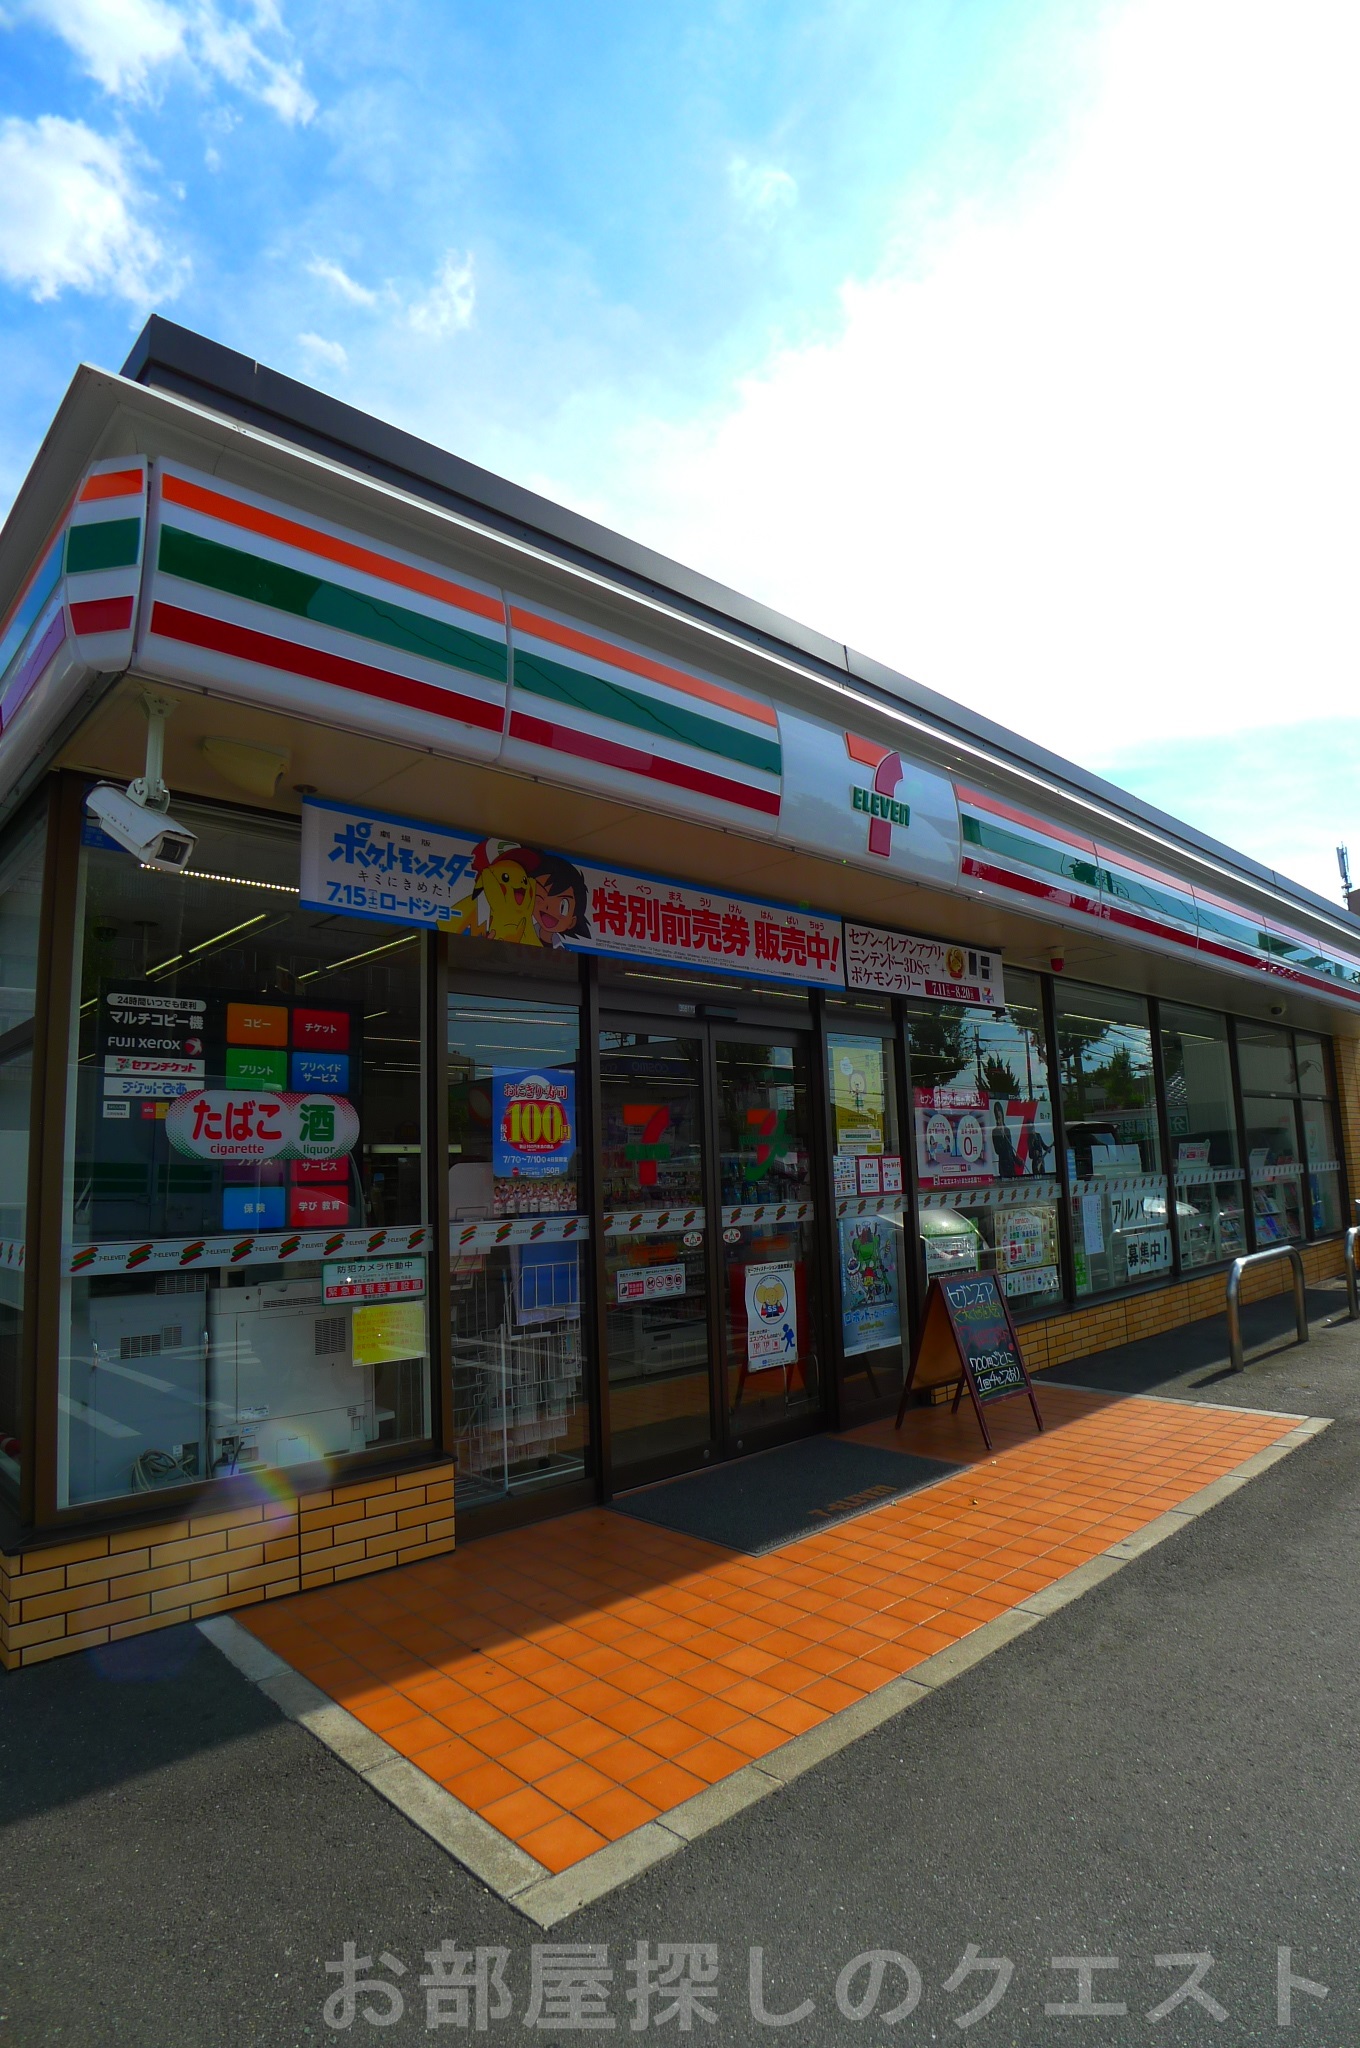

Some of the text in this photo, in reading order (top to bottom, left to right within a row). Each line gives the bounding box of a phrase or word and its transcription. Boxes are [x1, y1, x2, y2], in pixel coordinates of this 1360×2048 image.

[380, 830, 432, 848] 劇場版
[328, 822, 478, 887] ポケットモンスター
[604, 878, 618, 889] とく
[636, 885, 652, 895] べつ
[668, 891, 683, 902] まえ
[700, 897, 711, 908] うり
[728, 903, 742, 915] けん
[760, 910, 774, 921] はん
[592, 887, 750, 957] 特別前売券
[754, 920, 840, 973] 販売中!
[809, 920, 825, 931] ちゅう
[849, 949, 931, 976] ニンテンドー3DSで
[851, 965, 922, 992] ポケモンラリー
[117, 995, 197, 1010] 24時間いつでも便利
[109, 1010, 204, 1031] マルチコピー機
[243, 1018, 271, 1029] コピー
[304, 1022, 337, 1034] チケット
[107, 1036, 136, 1048] FUJI
[131, 1060, 197, 1073] セブンチケット
[238, 1064, 274, 1076] プリント
[299, 1061, 341, 1073] プリペイド
[303, 1072, 339, 1083] サービス
[122, 1081, 188, 1096] チケットぴあ
[192, 1099, 336, 1142] たばこ 酒
[210, 1144, 336, 1155] cigarette liquor
[301, 1161, 338, 1172] サービス
[243, 1202, 267, 1214] 保険
[298, 1200, 340, 1212] 学び 教育
[1128, 1236, 1168, 1267] 募集中!
[337, 1261, 413, 1274] 防犯カメラ作動中
